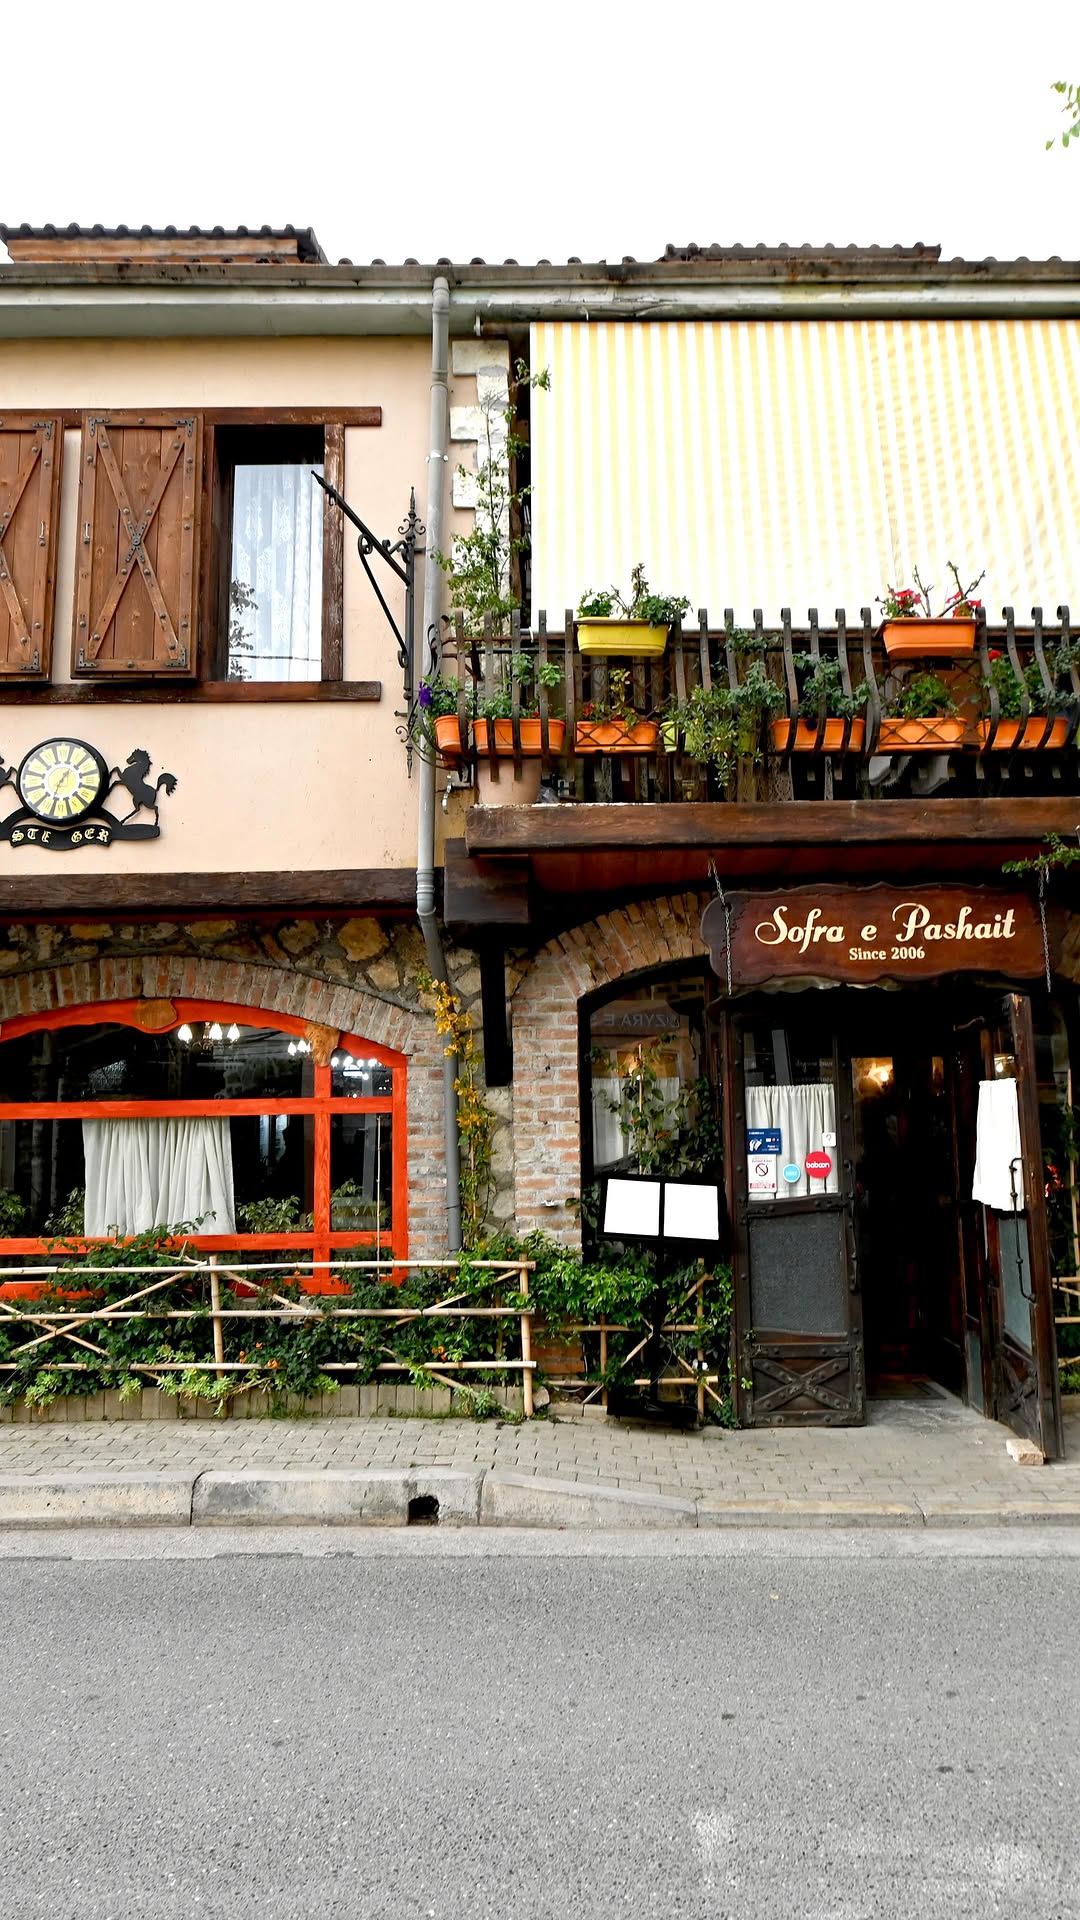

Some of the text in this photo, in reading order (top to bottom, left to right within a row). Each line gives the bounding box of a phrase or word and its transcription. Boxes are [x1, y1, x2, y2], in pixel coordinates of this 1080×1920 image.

[754, 902, 1016, 954] Sofra e Pashait
[849, 945, 926, 961] Since 2006
